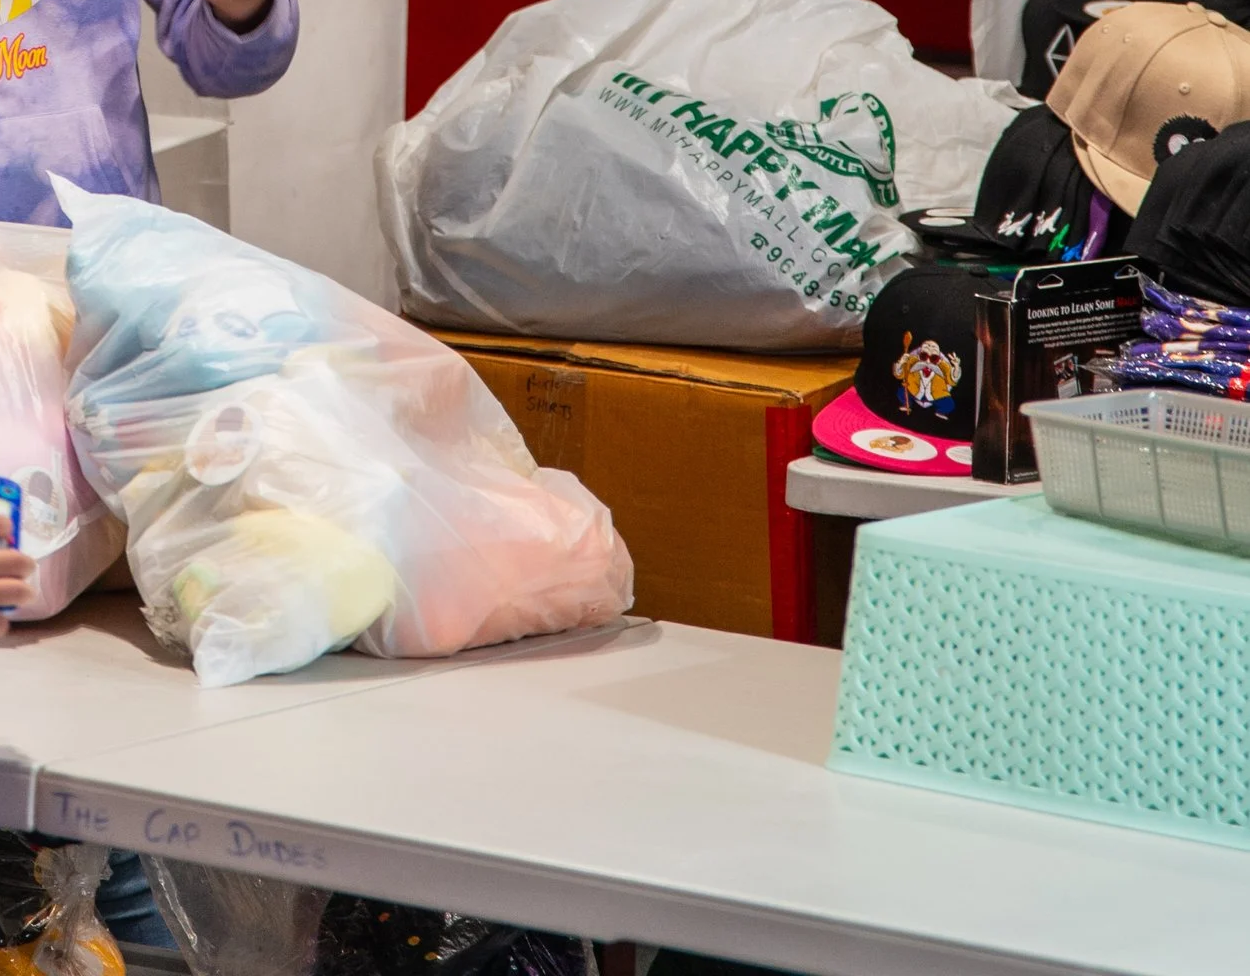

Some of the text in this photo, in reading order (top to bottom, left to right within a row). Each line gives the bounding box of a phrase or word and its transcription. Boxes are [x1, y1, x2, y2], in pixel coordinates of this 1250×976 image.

[670, 100, 821, 202] HAPPY
[1027, 307, 1060, 320] LOOKING
[1071, 302, 1095, 314] LEARN
[1095, 299, 1115, 311] SOME
